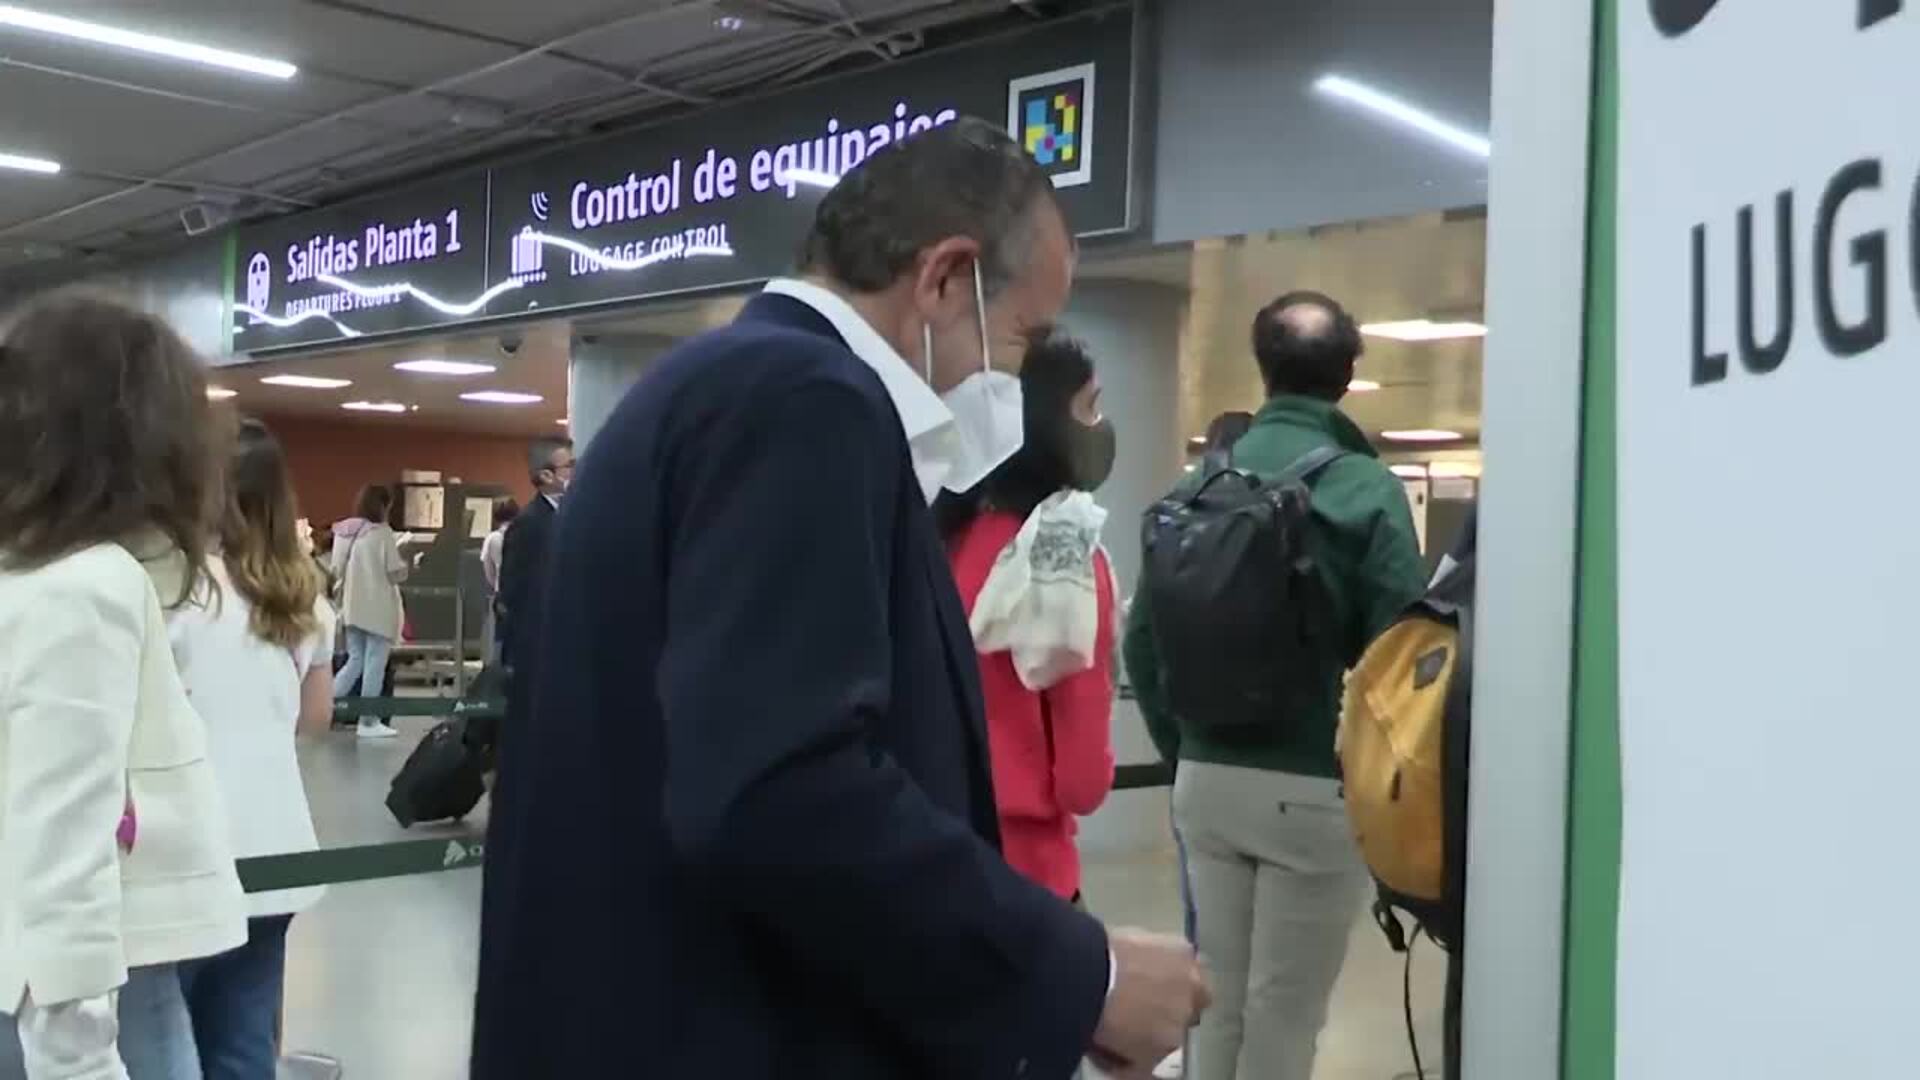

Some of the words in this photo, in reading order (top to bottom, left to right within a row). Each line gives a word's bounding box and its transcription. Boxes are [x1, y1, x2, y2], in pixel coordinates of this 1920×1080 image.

[571, 158, 681, 230] Control
[693, 149, 737, 203] de
[287, 234, 359, 284] Salidas
[365, 218, 438, 268] Planta
[446, 209, 462, 253] 1
[651, 223, 730, 261] CONTROL
[1690, 155, 1920, 388] LUG
